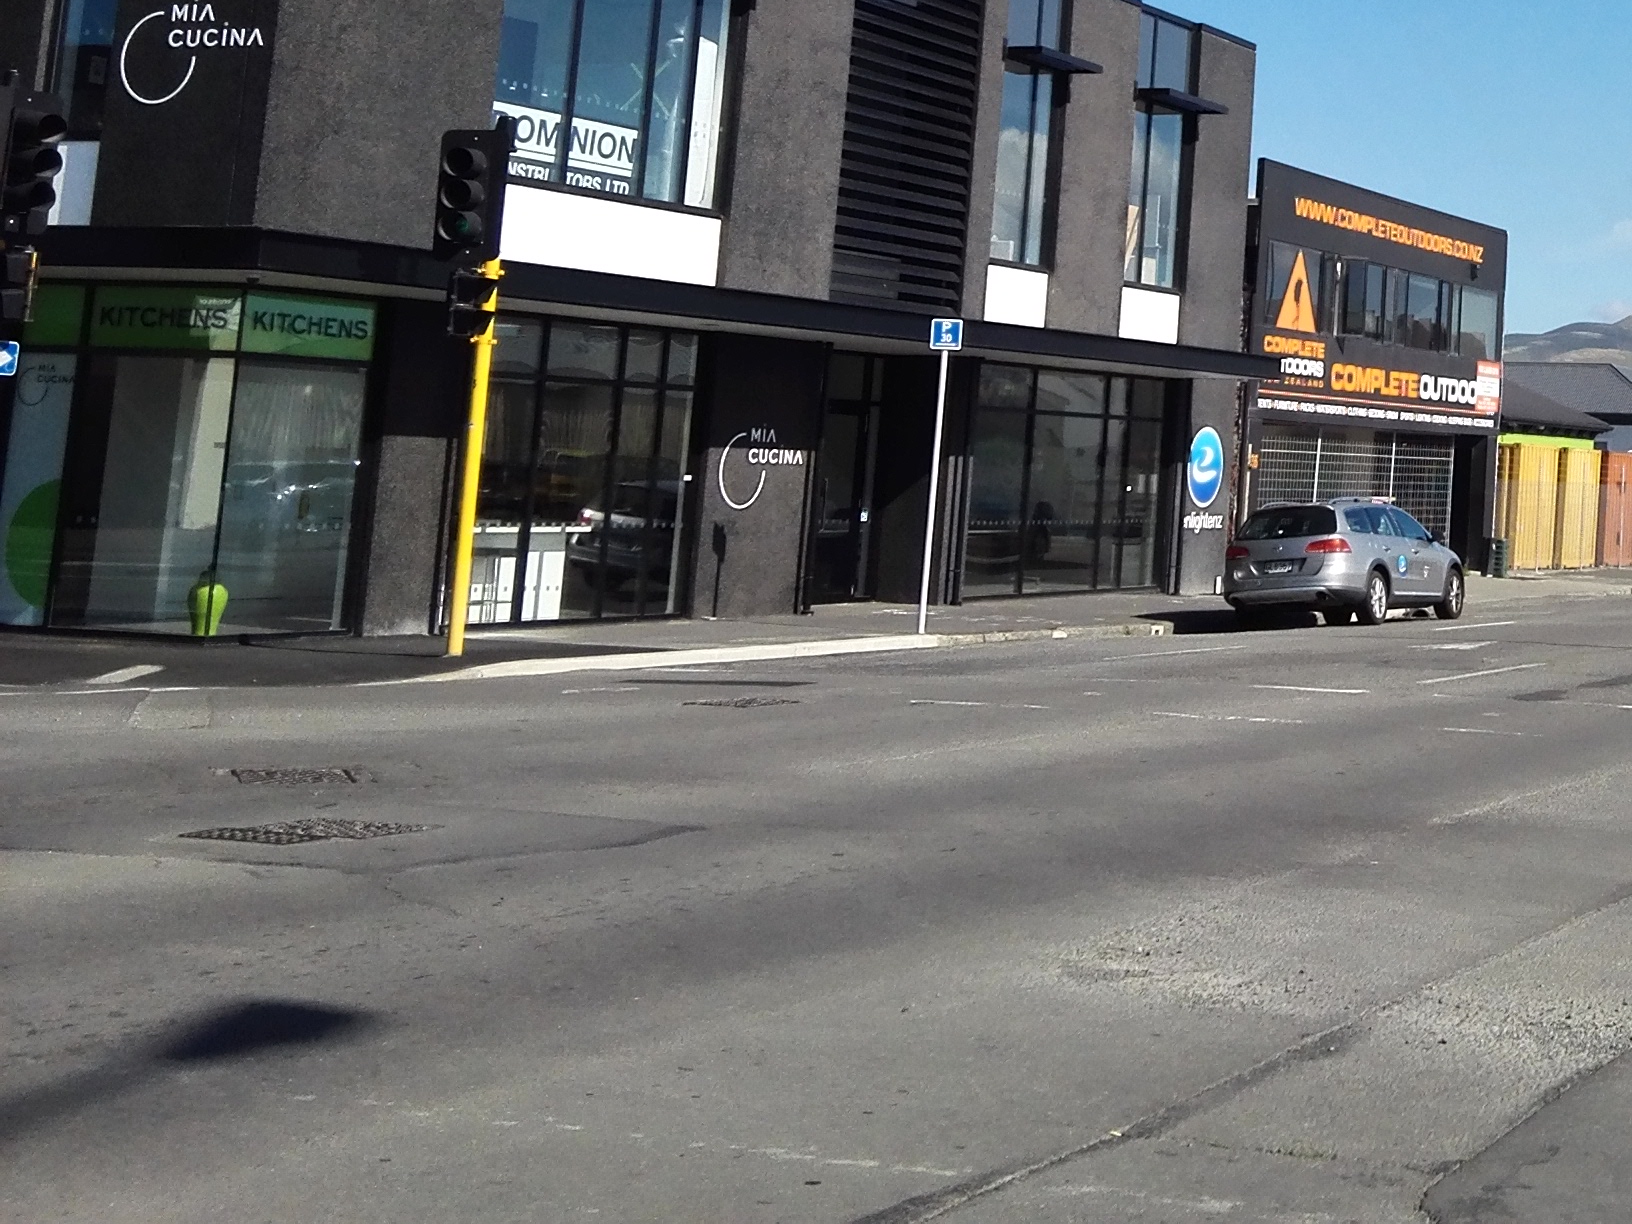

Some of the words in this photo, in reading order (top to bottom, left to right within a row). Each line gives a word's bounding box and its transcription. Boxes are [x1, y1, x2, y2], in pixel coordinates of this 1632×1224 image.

[168, 21, 264, 48] CUCINA
[492, 109, 634, 163] OMNION
[1294, 197, 1484, 263] WWW.COMPLETEOUTDOORS.CO.NZ
[100, 305, 229, 329] KITCHENS
[253, 309, 369, 340] KITCHENS
[942, 321, 952, 332] P
[940, 333, 952, 343] 30
[1264, 335, 1325, 359] COMPLETE
[1281, 358, 1324, 377] TDOORS
[1284, 377, 1324, 388] ZEALAND
[1331, 363, 1419, 398] COMPLETE
[1420, 374, 1477, 405] OUTDOO
[751, 423, 776, 443] MIA
[748, 445, 803, 465] CUCINA
[1183, 511, 1223, 533] enlightenz
